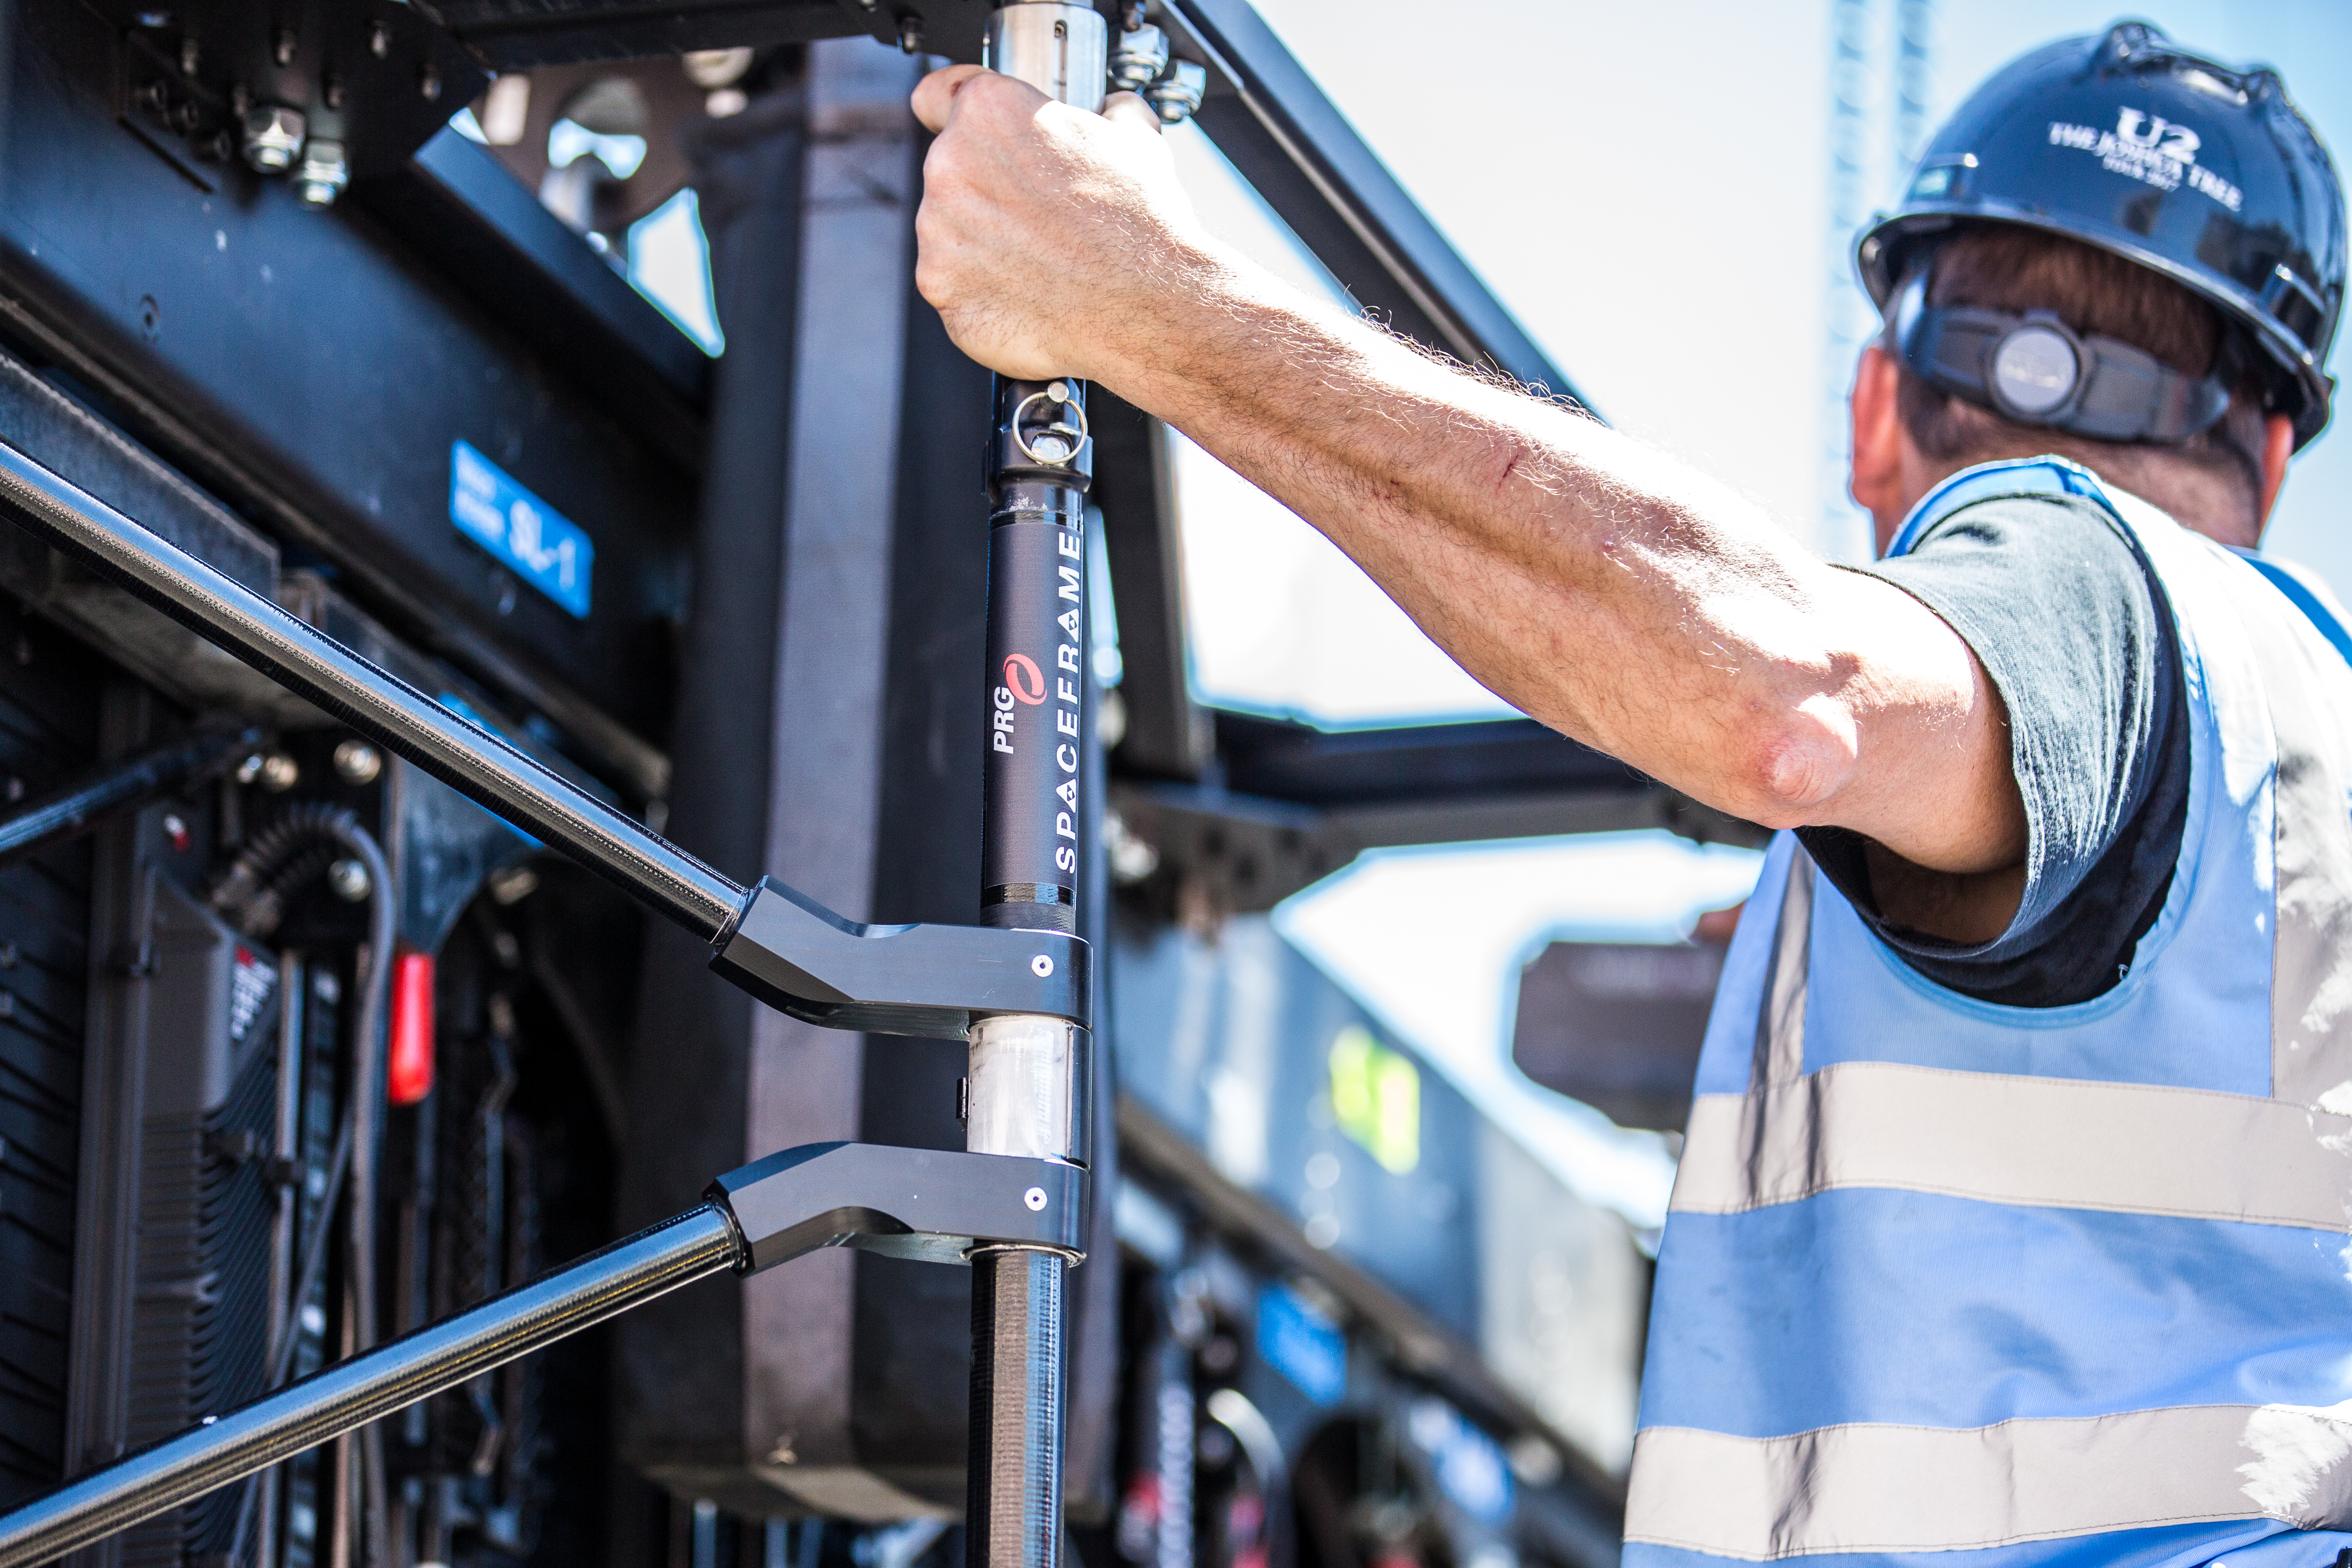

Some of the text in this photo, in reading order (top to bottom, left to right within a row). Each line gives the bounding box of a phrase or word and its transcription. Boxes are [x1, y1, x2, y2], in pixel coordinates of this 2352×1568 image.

[2118, 106, 2201, 164] U2
[2188, 164, 2243, 212] TREE
[994, 686, 1015, 754] PRG
[1055, 532, 1081, 875] SPACEFRAME
